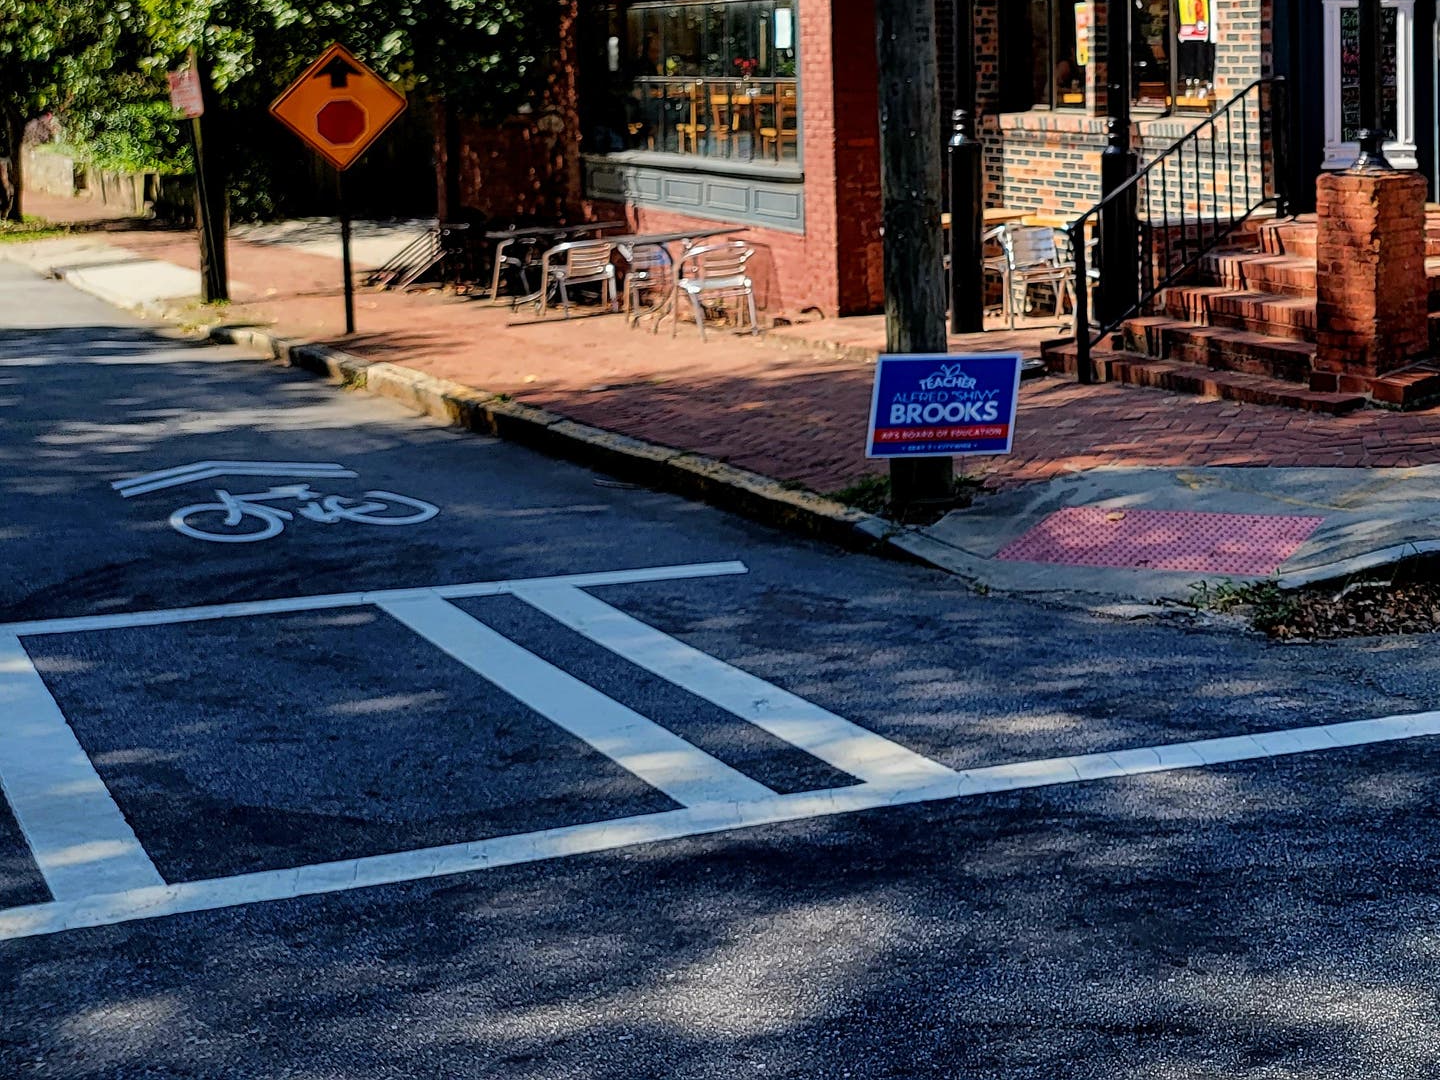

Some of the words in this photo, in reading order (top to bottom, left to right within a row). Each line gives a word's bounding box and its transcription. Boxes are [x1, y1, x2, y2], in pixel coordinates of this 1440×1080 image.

[919, 377, 977, 390] TEACHER
[893, 390, 949, 403] ALFRED
[889, 400, 998, 425] BROOKS
[902, 430, 934, 440] BOARD
[936, 429, 949, 438] OF
[951, 427, 1002, 438] EDUCATION
